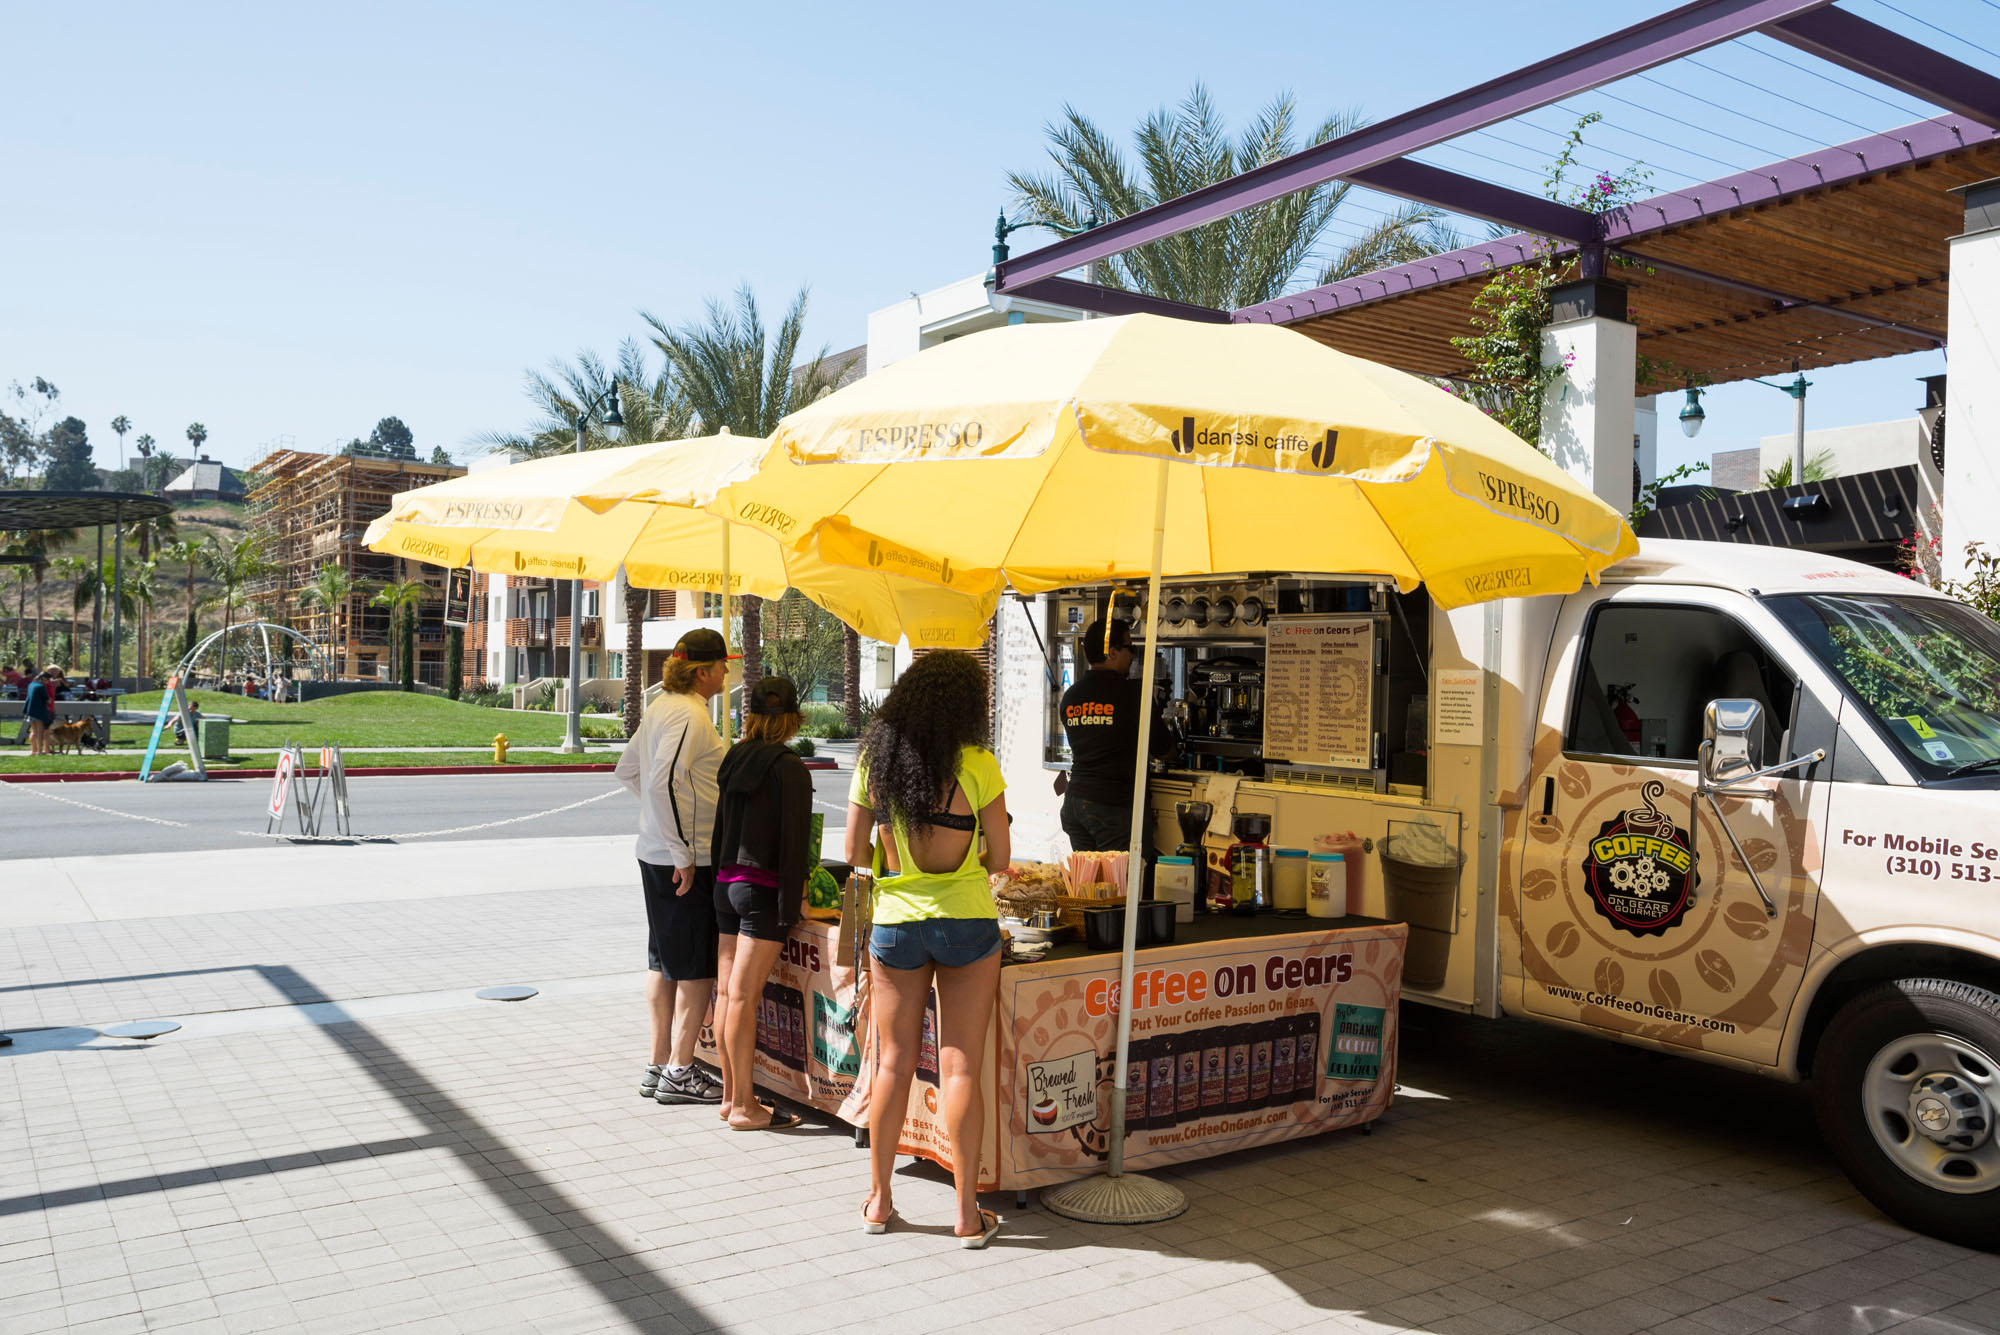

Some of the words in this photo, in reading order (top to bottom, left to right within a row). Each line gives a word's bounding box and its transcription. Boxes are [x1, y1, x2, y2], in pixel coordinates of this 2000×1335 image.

[858, 421, 983, 453] ESPRESSO
[1197, 427, 1259, 448] danesi
[445, 502, 523, 521] ESPRESSO
[1313, 626, 1325, 635] on
[1326, 626, 1351, 635] Gears
[1066, 702, 1114, 719] Coffee
[1067, 717, 1079, 727] on
[1080, 715, 1113, 726] Gears
[1594, 836, 1692, 872] COFFEE
[1842, 829, 1877, 848] For
[1883, 833, 1963, 857] Mobile
[1970, 842, 2000, 861] Se
[1886, 855, 1942, 881] (310)
[1607, 896, 1623, 906] ON
[1629, 899, 1669, 913] GEARS
[1614, 903, 1663, 918] GOURMET
[780, 936, 821, 974] ears
[1214, 962, 1257, 998] on
[1264, 953, 1353, 992] Gears
[1131, 1017, 1152, 1032] Put
[1154, 1013, 1180, 1028] Your
[1184, 1007, 1222, 1024] Coffee
[1225, 1001, 1265, 1018] Passion
[1268, 999, 1283, 1012] On
[1286, 996, 1314, 1009] Gears
[1547, 984, 1736, 1034] www.CoffeeOnGears.com
[1339, 1022, 1379, 1037] ORGANIC
[1030, 1060, 1077, 1092] Brewed
[1061, 1082, 1095, 1110] Fresh
[1319, 1096, 1331, 1104] For
[901, 1130, 930, 1143] NTRAL
[1148, 1110, 1288, 1146] www.CoffeeOnGears.com
